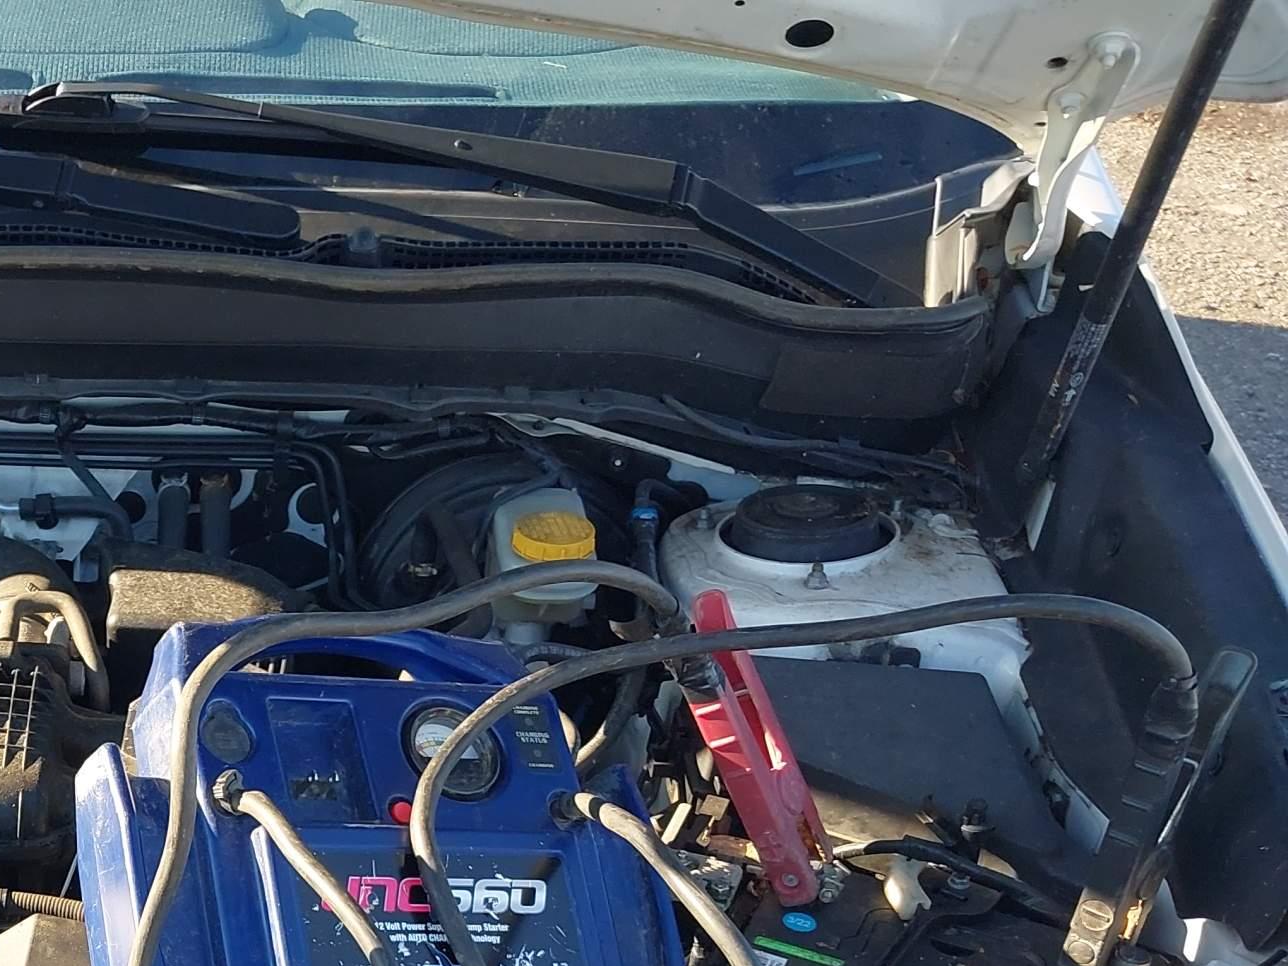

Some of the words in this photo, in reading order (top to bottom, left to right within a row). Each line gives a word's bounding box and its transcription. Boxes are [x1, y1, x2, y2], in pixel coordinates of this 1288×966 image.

[385, 922, 401, 931] Volt
[401, 922, 426, 931] Power
[482, 923, 510, 932] Starter
[389, 934, 407, 942] with
